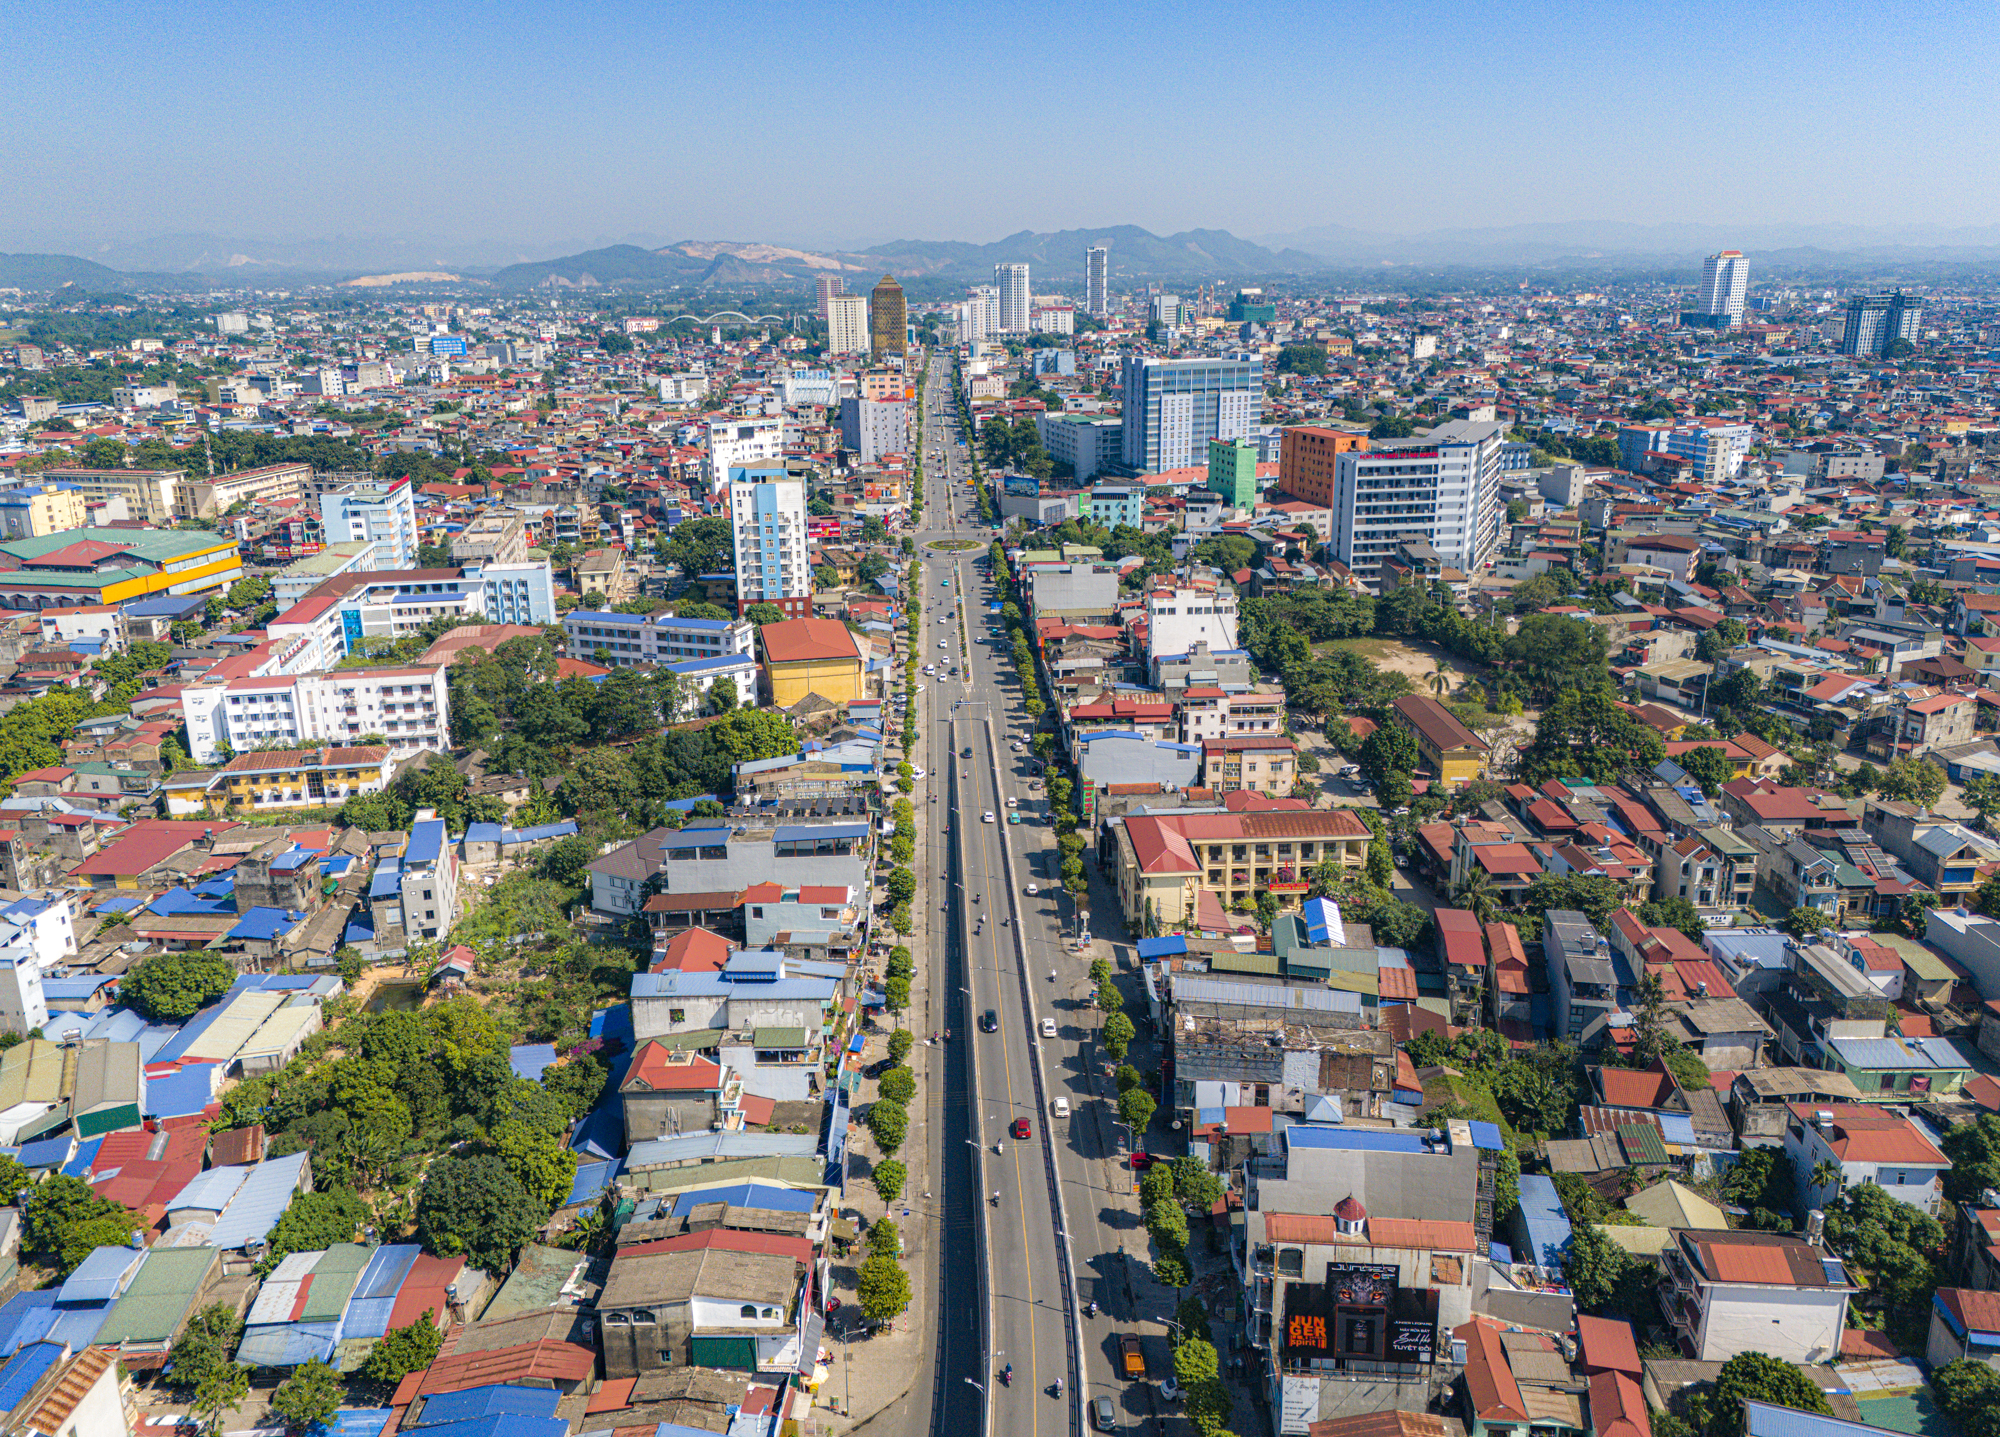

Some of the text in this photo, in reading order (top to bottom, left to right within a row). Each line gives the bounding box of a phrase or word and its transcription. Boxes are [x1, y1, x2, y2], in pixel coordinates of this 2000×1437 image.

[1332, 1264, 1396, 1273] JUNGER
[1290, 1315, 1325, 1326] JUN
[1290, 1325, 1326, 1337] GER
[1290, 1338, 1316, 1347] spirit
